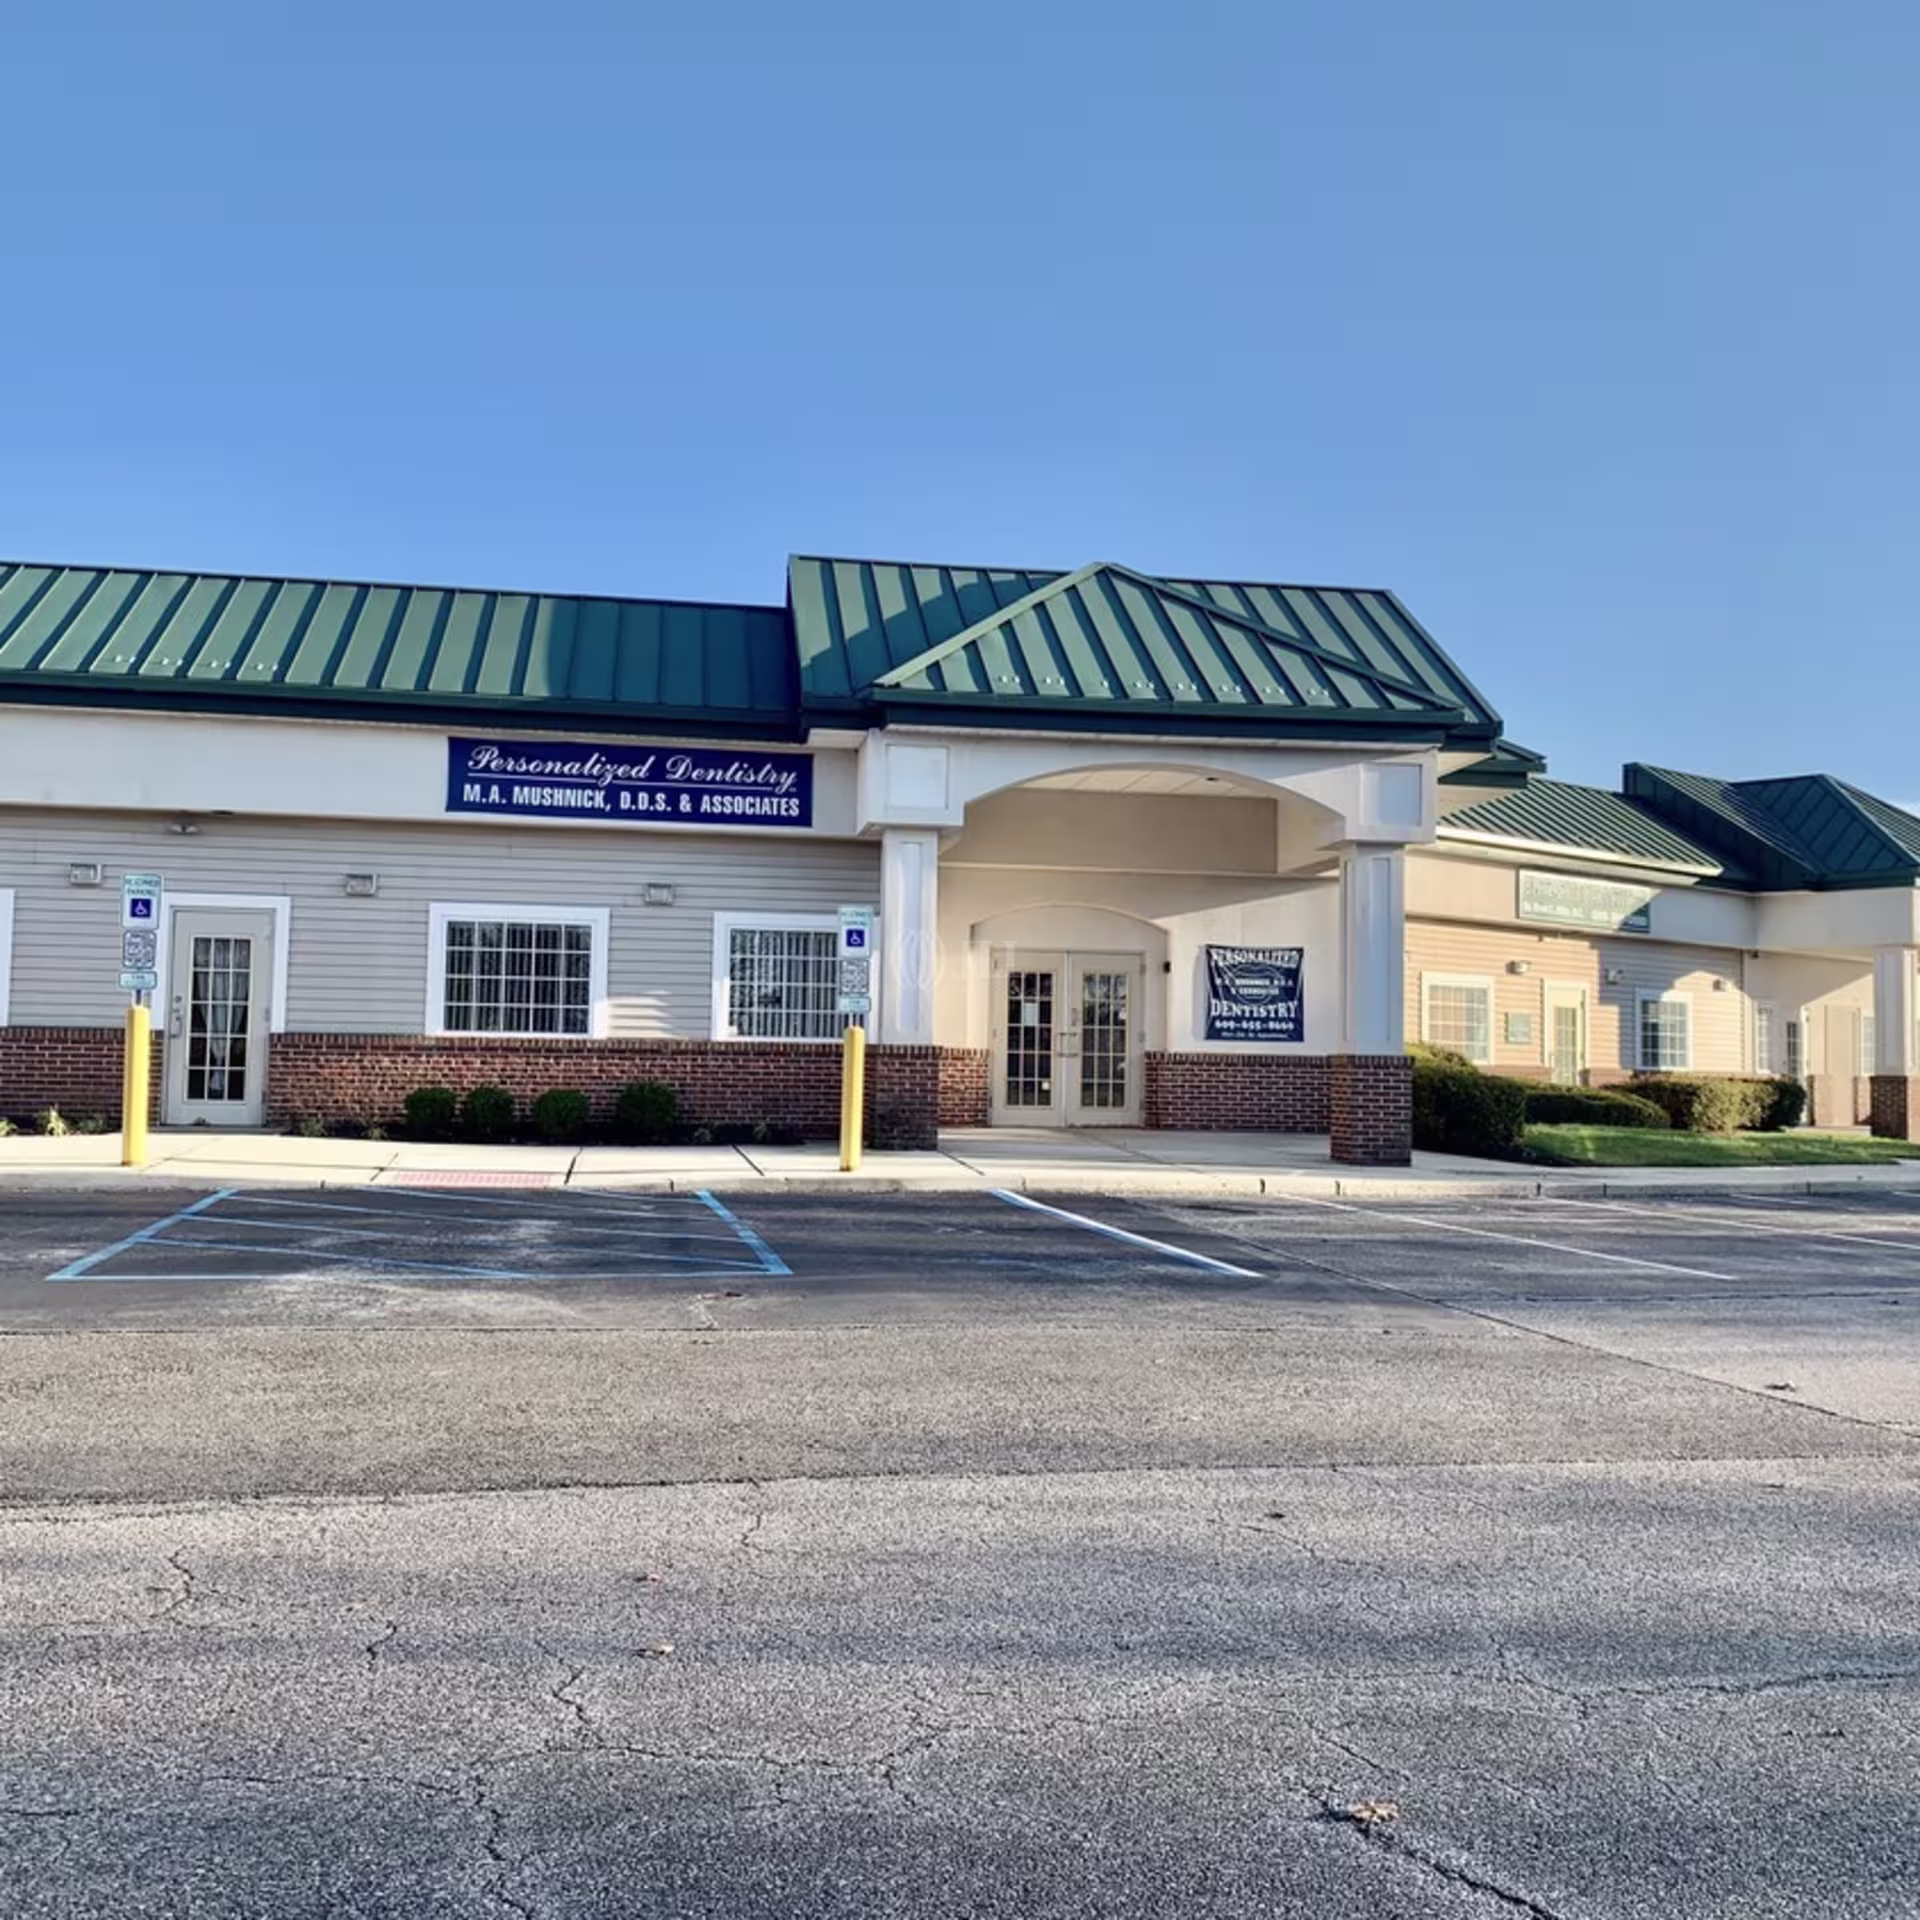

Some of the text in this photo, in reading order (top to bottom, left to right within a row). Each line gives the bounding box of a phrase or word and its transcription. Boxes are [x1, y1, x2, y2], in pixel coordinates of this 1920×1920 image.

[467, 745, 797, 794] Personalized Dentistry
[463, 784, 800, 817] M.A. MUSHNICK, D.D.S. & ASSOCIATES
[1211, 998, 1297, 1018] DENTISTRY
